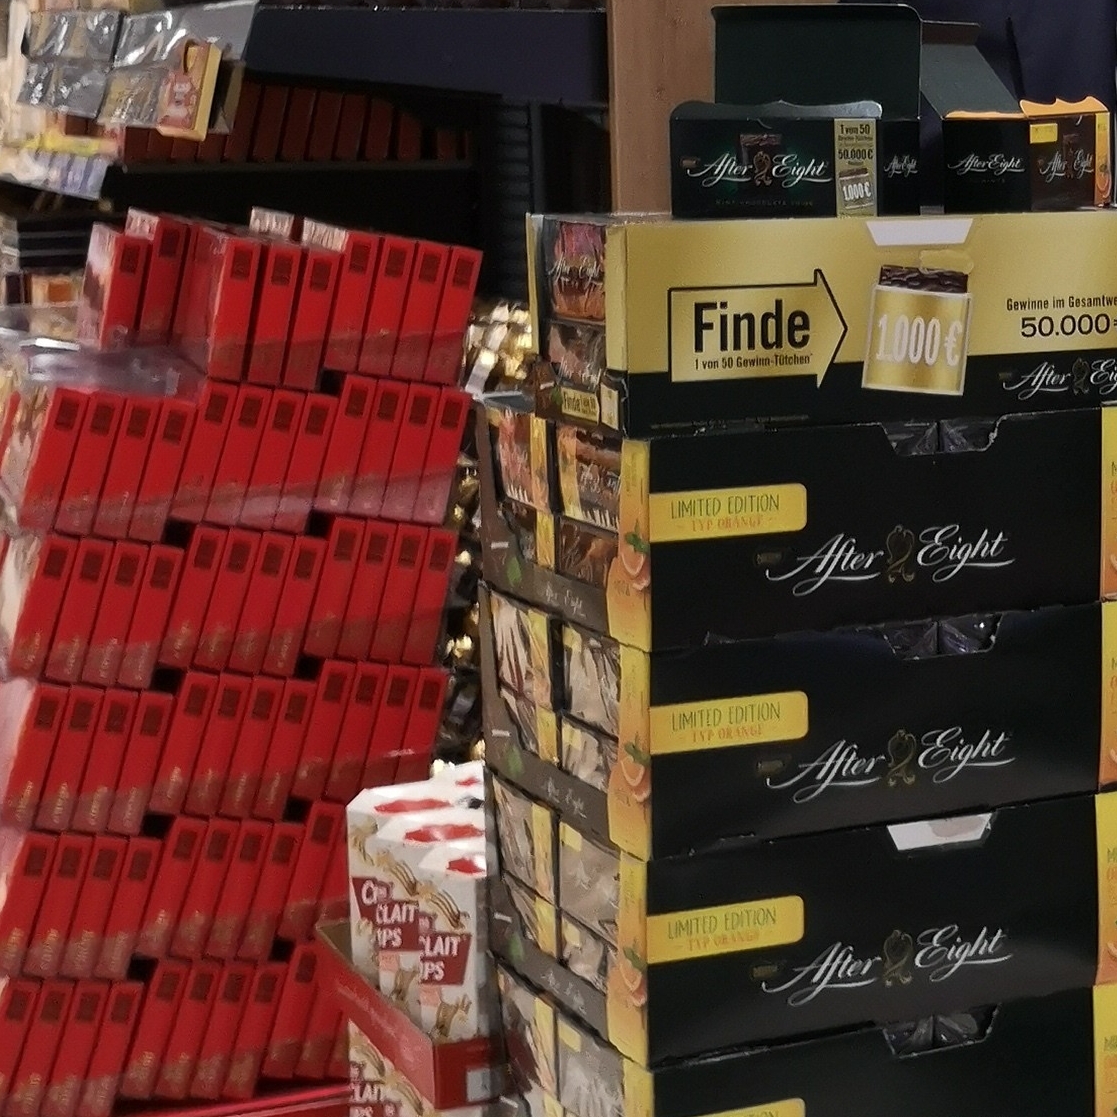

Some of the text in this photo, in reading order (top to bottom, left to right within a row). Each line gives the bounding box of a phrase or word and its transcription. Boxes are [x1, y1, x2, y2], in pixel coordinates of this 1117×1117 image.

[860, 124, 870, 134] 50
[694, 152, 833, 189] After Eight
[948, 152, 1025, 176] After Eight
[1040, 150, 1067, 182] After
[1006, 296, 1050, 312] Gewinne
[1052, 294, 1066, 308] im
[693, 297, 811, 353] Finde
[694, 359, 699, 371] 1
[702, 359, 718, 370] von
[721, 357, 734, 370] 50
[1003, 360, 1072, 399] After
[671, 493, 780, 520] LIMITED EDITION
[766, 524, 1015, 596] After Eight
[671, 701, 781, 733] LIMITED EDITION
[766, 726, 1015, 803] After Eight
[667, 906, 777, 939] LIMITED EDITION
[761, 924, 1013, 1006] After Eight
